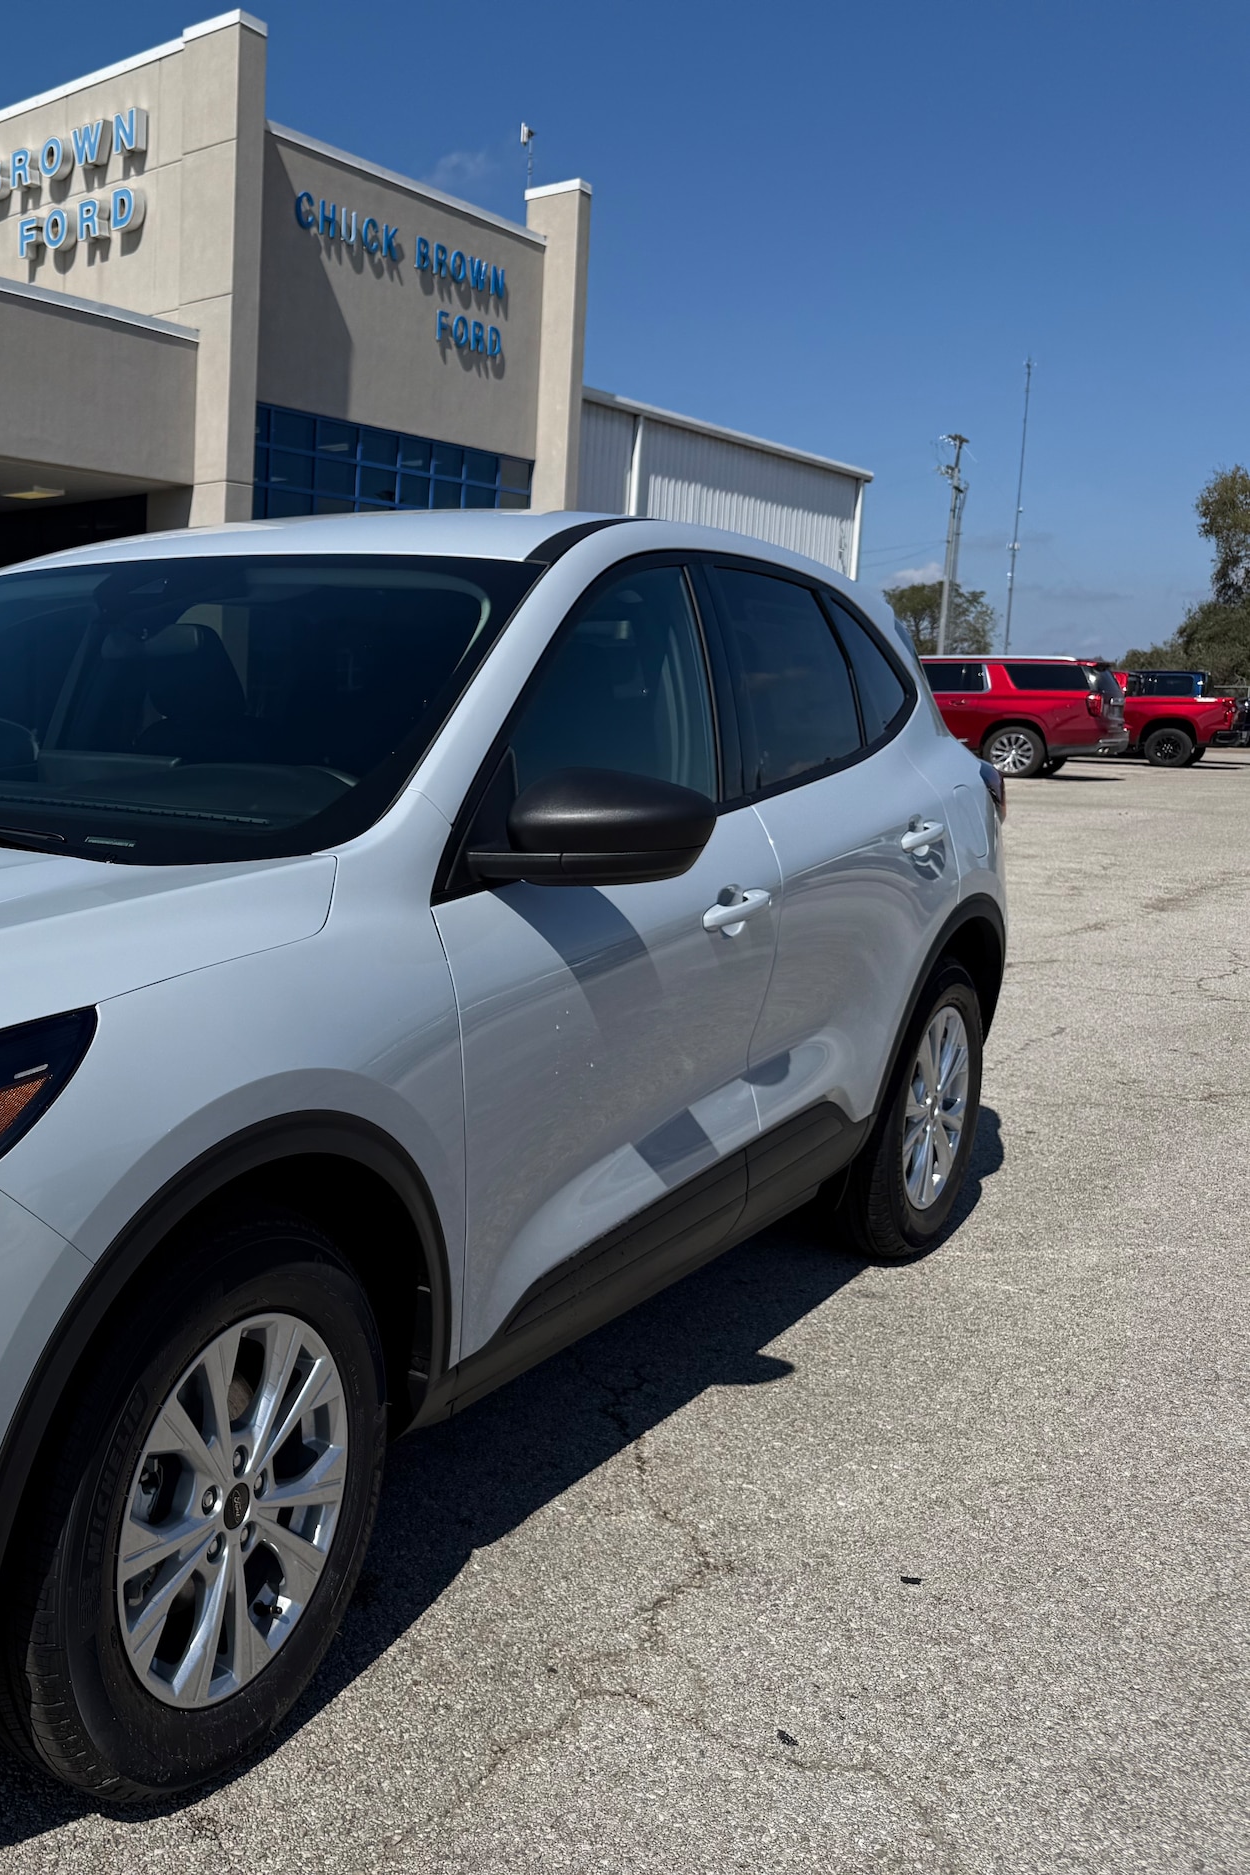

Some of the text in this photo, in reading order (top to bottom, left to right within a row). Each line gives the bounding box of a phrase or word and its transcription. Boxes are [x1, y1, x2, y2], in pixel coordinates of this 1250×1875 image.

[18, 187, 138, 260] FORD
[295, 191, 505, 298] CHUCK BROWN
[436, 310, 502, 356] FORD
